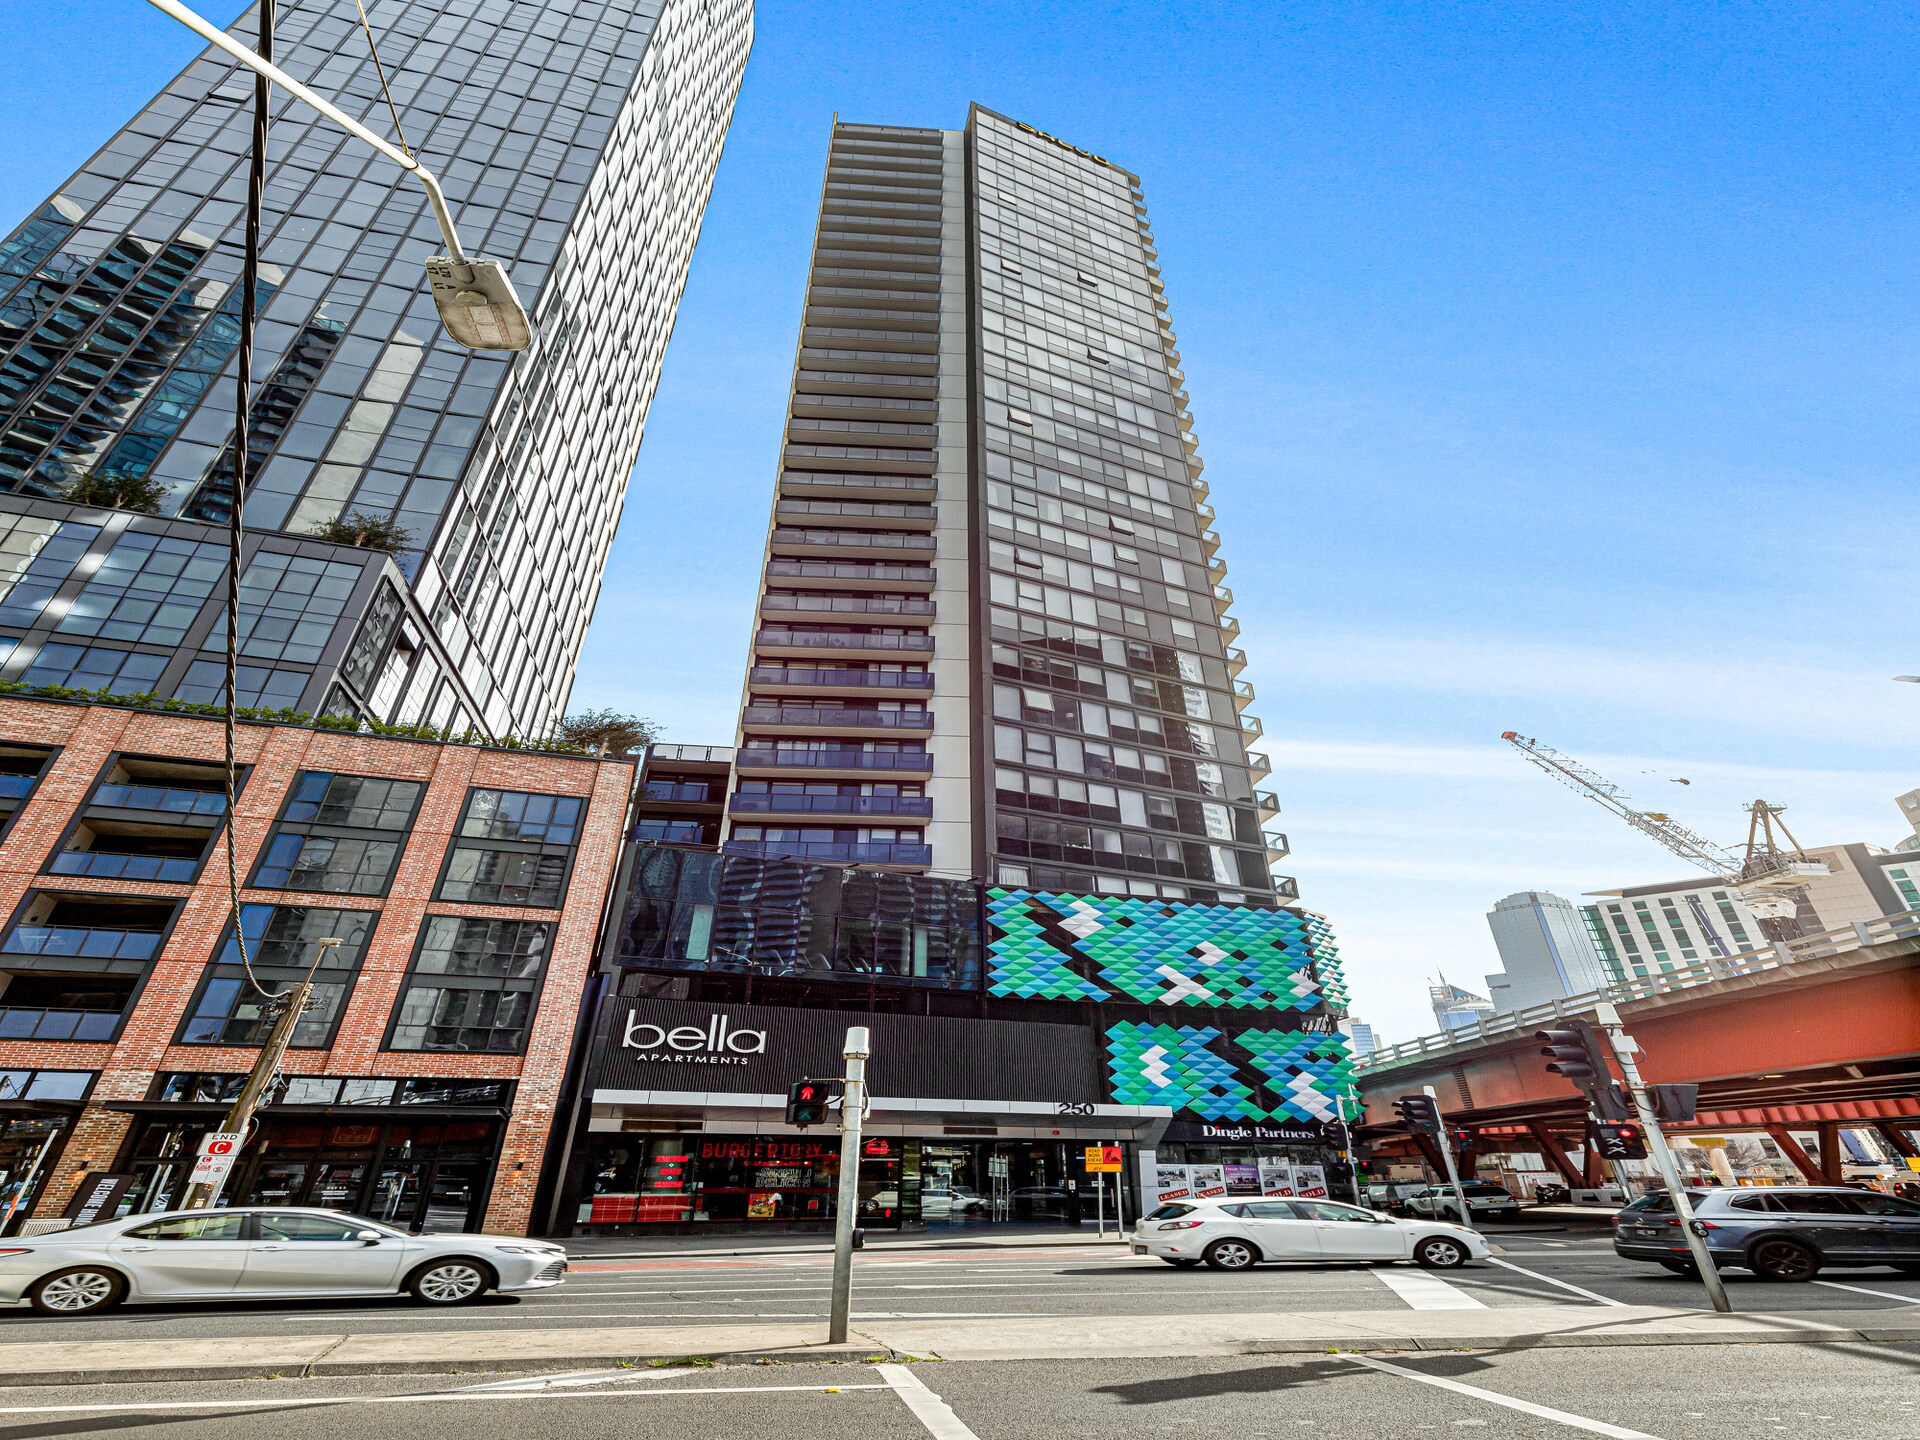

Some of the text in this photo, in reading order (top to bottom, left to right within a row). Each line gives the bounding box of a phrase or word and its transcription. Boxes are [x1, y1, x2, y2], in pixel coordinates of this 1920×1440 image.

[622, 1008, 767, 1054] bella
[637, 1053, 749, 1066] APARTMENTS
[1058, 1102, 1095, 1116] 250
[1202, 1125, 1316, 1141] Dingle Partners
[214, 1142, 227, 1154] C
[83, 1178, 119, 1208] WELCOME
[1159, 1189, 1188, 1201] LEASED
[1300, 1188, 1324, 1198] SOLD
